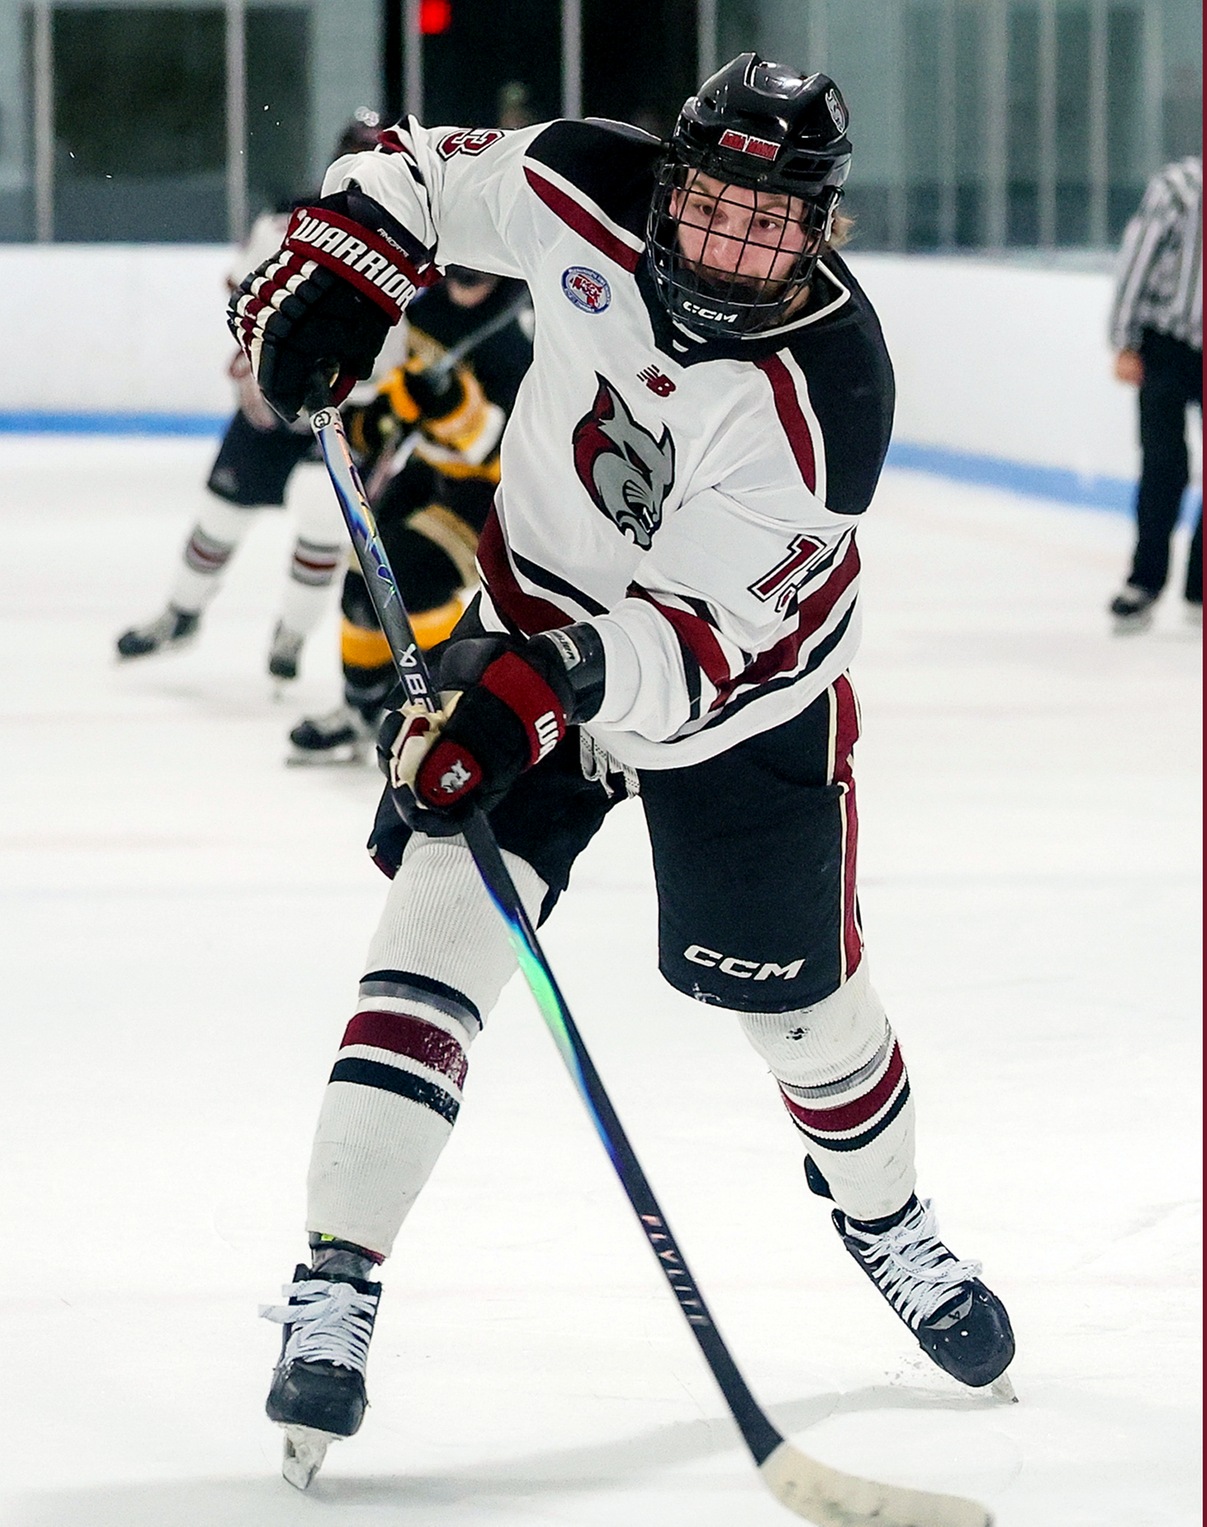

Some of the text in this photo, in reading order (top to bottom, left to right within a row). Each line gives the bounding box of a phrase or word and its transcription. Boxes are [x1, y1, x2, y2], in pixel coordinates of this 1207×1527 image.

[293, 210, 417, 311] WARRIOR
[683, 300, 738, 323] CCM
[683, 944, 806, 982] CCM
